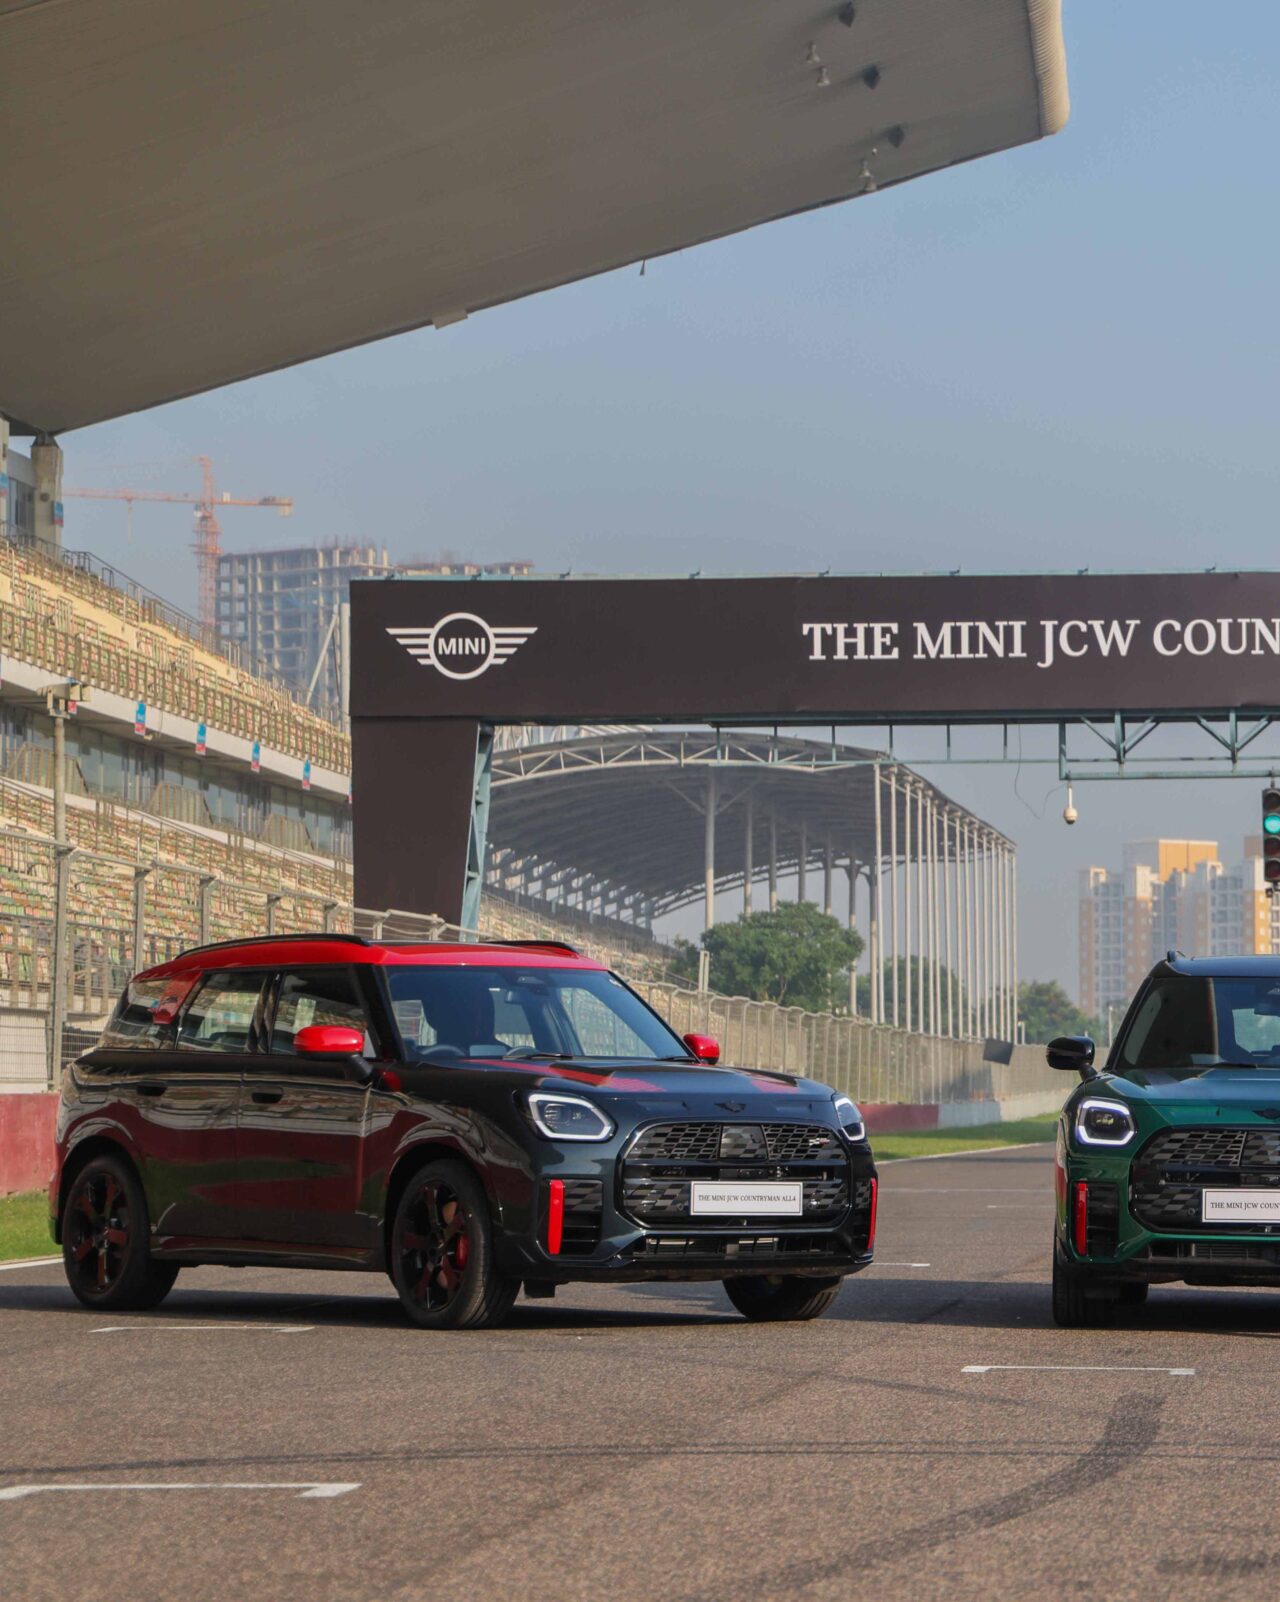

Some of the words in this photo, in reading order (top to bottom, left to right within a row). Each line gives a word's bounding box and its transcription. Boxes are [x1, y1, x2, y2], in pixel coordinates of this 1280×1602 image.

[437, 636, 486, 656] MINI
[802, 622, 899, 660] THE
[912, 620, 1027, 659] MINI
[1036, 619, 1141, 668] JCW
[698, 1194, 711, 1202] THE
[711, 1194, 726, 1202] MINI
[727, 1194, 739, 1203] JCW
[740, 1194, 781, 1202] COUNTRYMAN
[1244, 1202, 1259, 1211] JCW
